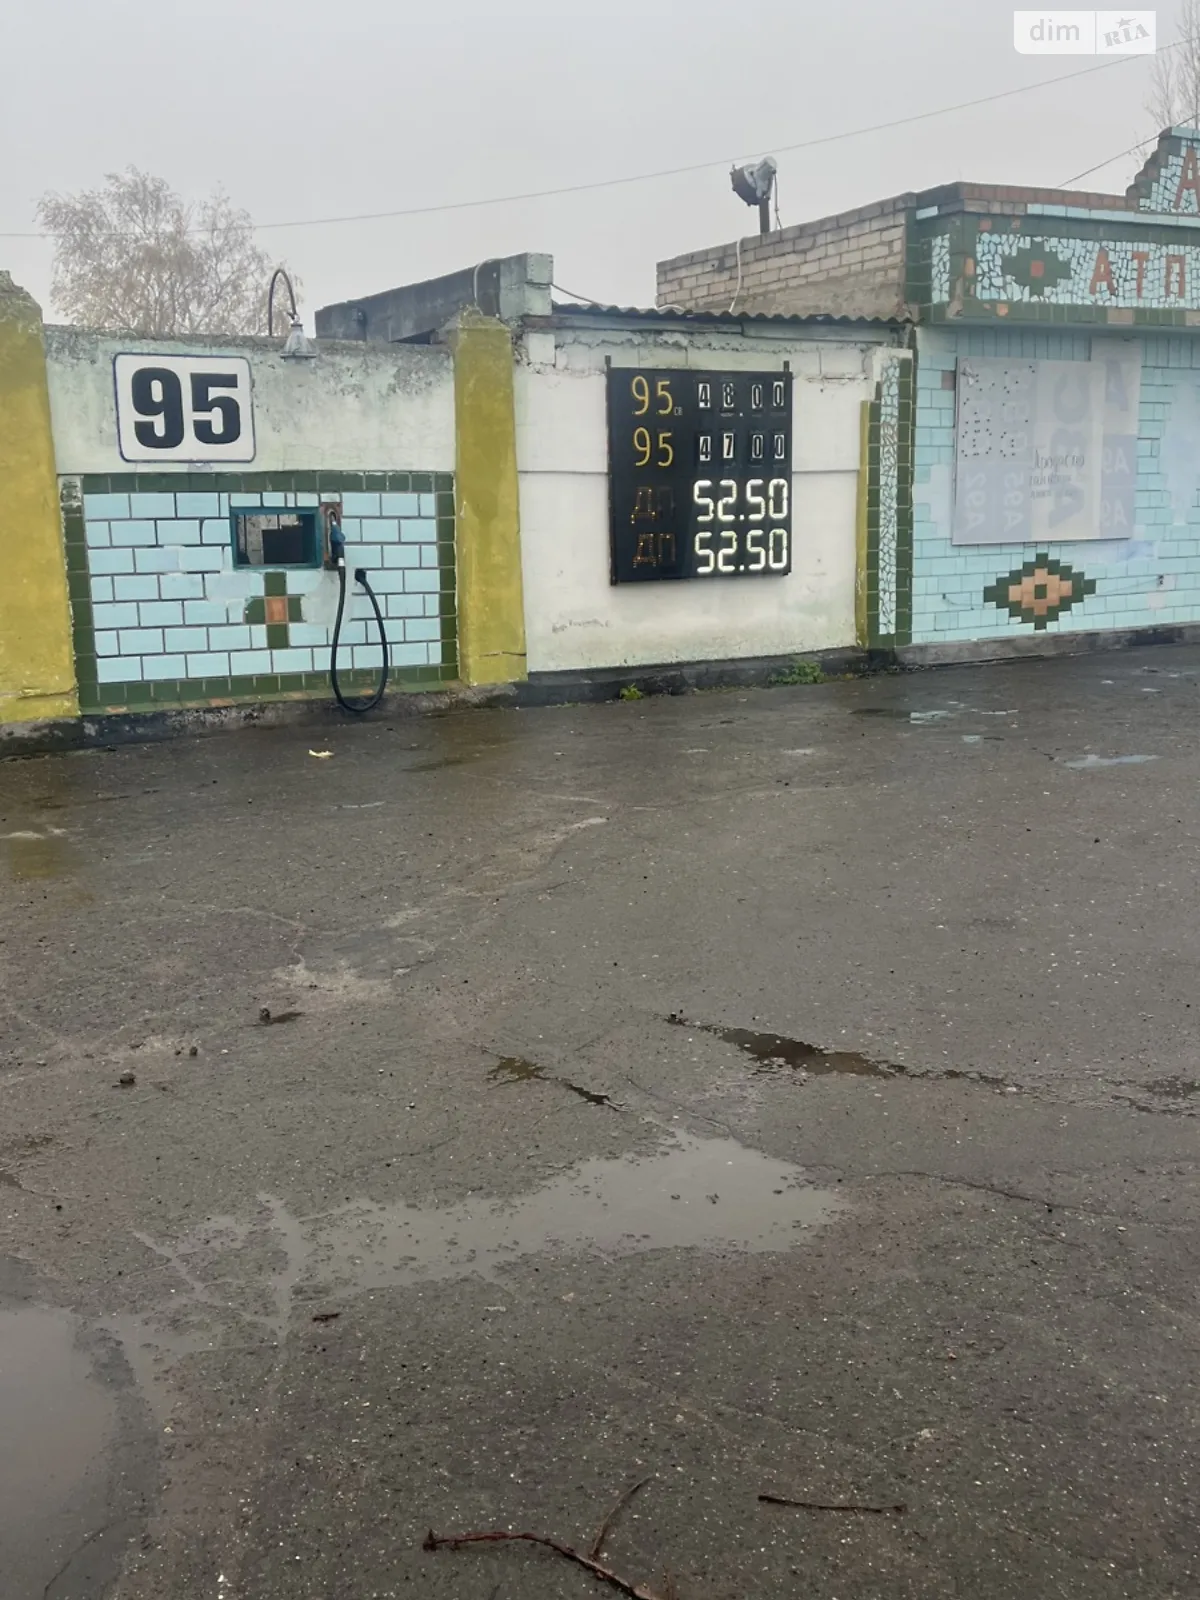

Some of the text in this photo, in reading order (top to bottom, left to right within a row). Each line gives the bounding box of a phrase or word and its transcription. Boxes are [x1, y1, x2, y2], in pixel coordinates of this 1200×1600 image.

[131, 367, 241, 449] 95
[632, 376, 673, 415] 95
[633, 427, 673, 467] 95
[693, 478, 788, 522] 52.50
[694, 528, 788, 573] 52.50
